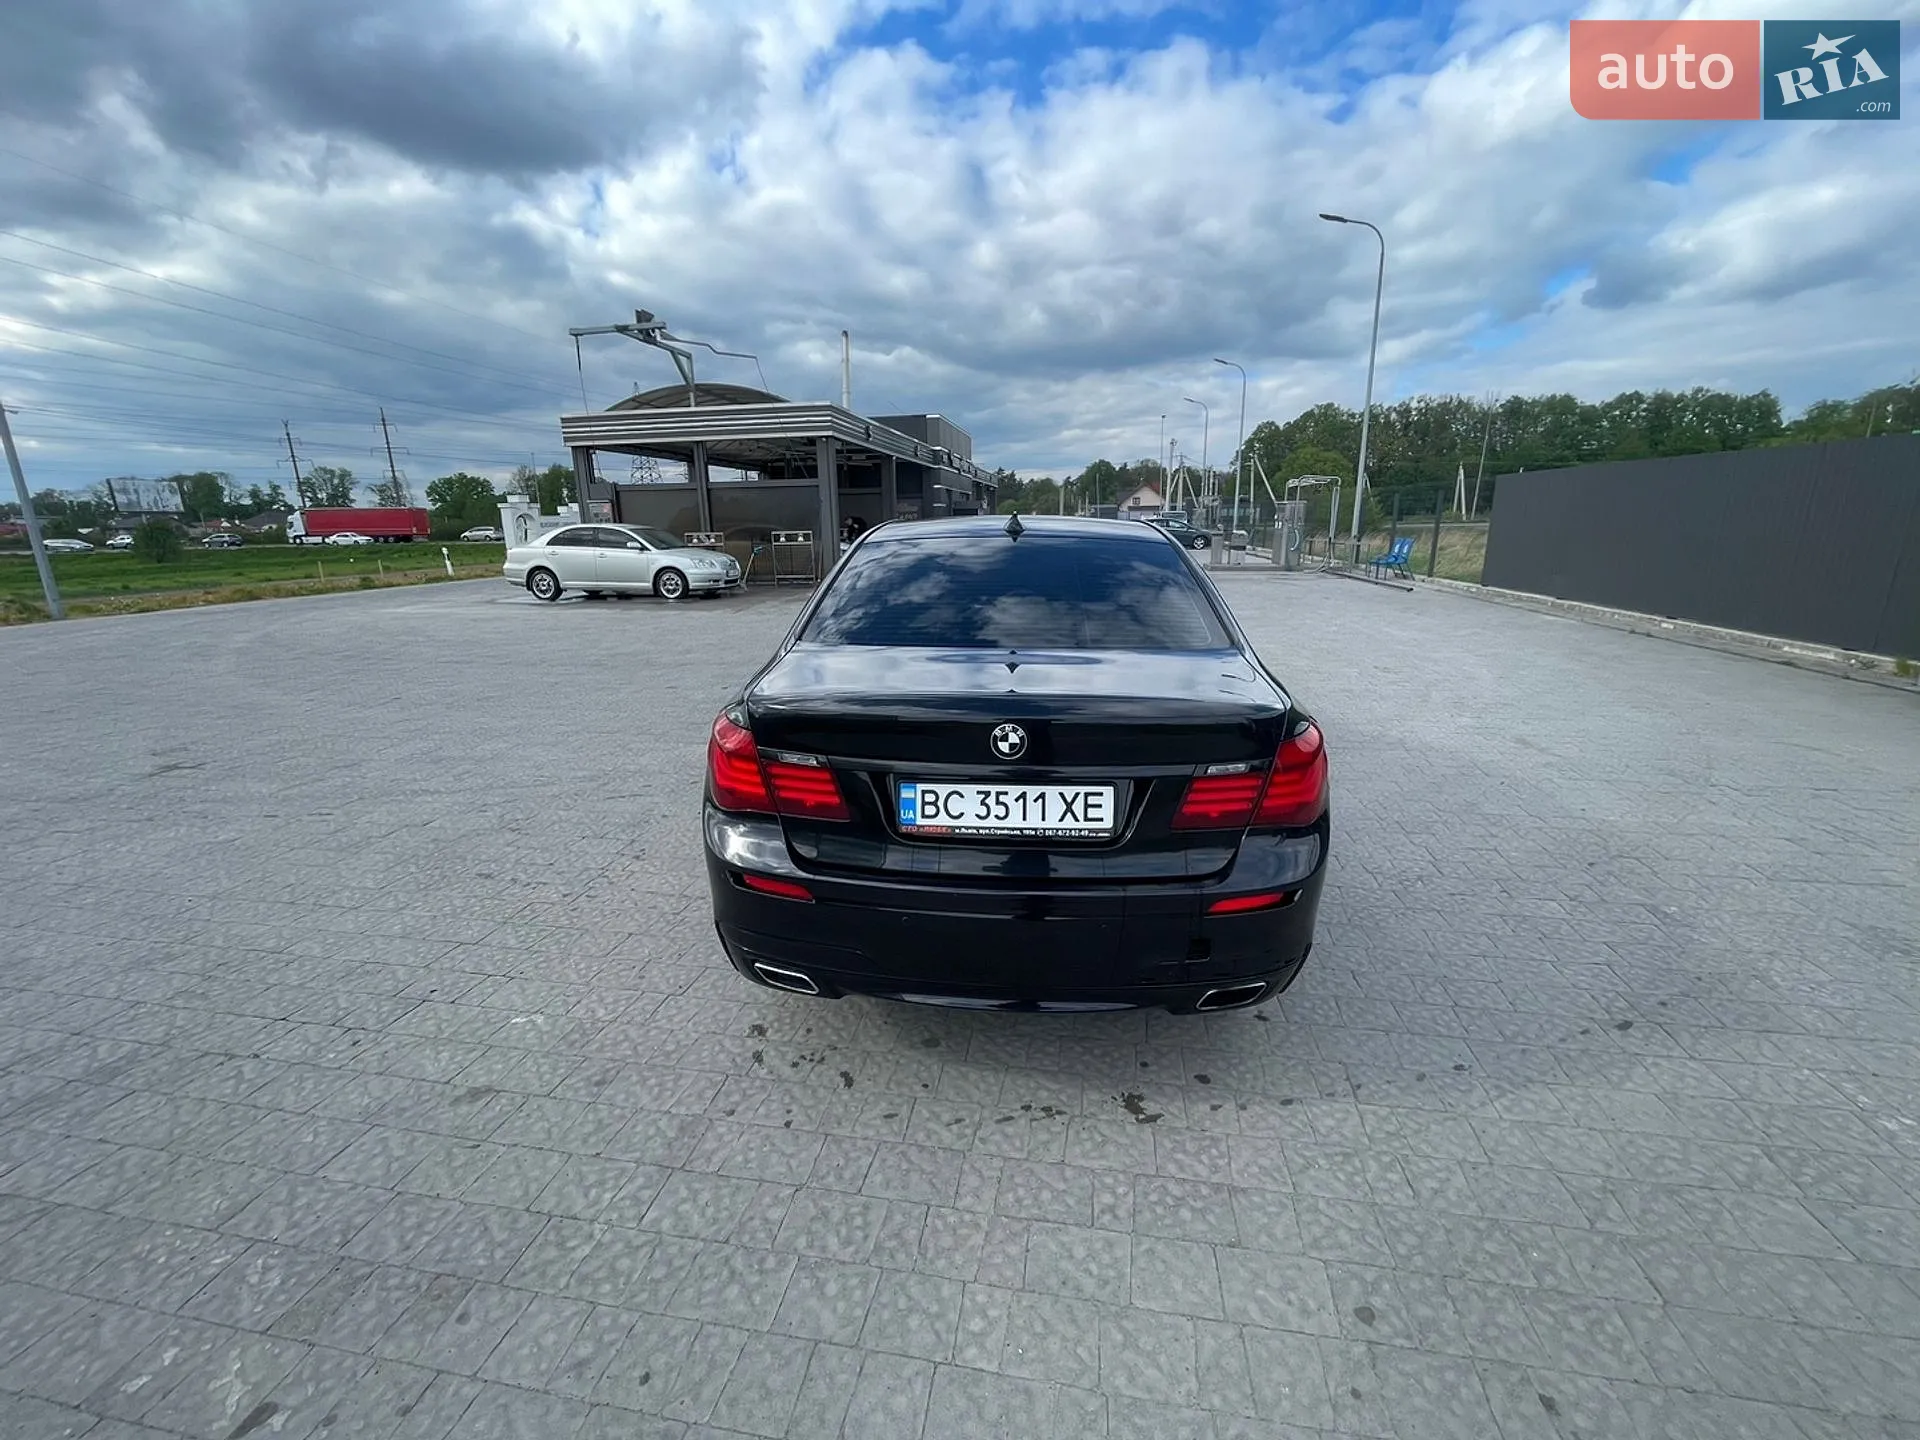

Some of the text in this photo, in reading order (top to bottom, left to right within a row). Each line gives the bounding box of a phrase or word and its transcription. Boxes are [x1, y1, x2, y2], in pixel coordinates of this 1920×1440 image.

[900, 810, 915, 819] UA
[920, 789, 1104, 823] BC 3511 XE
